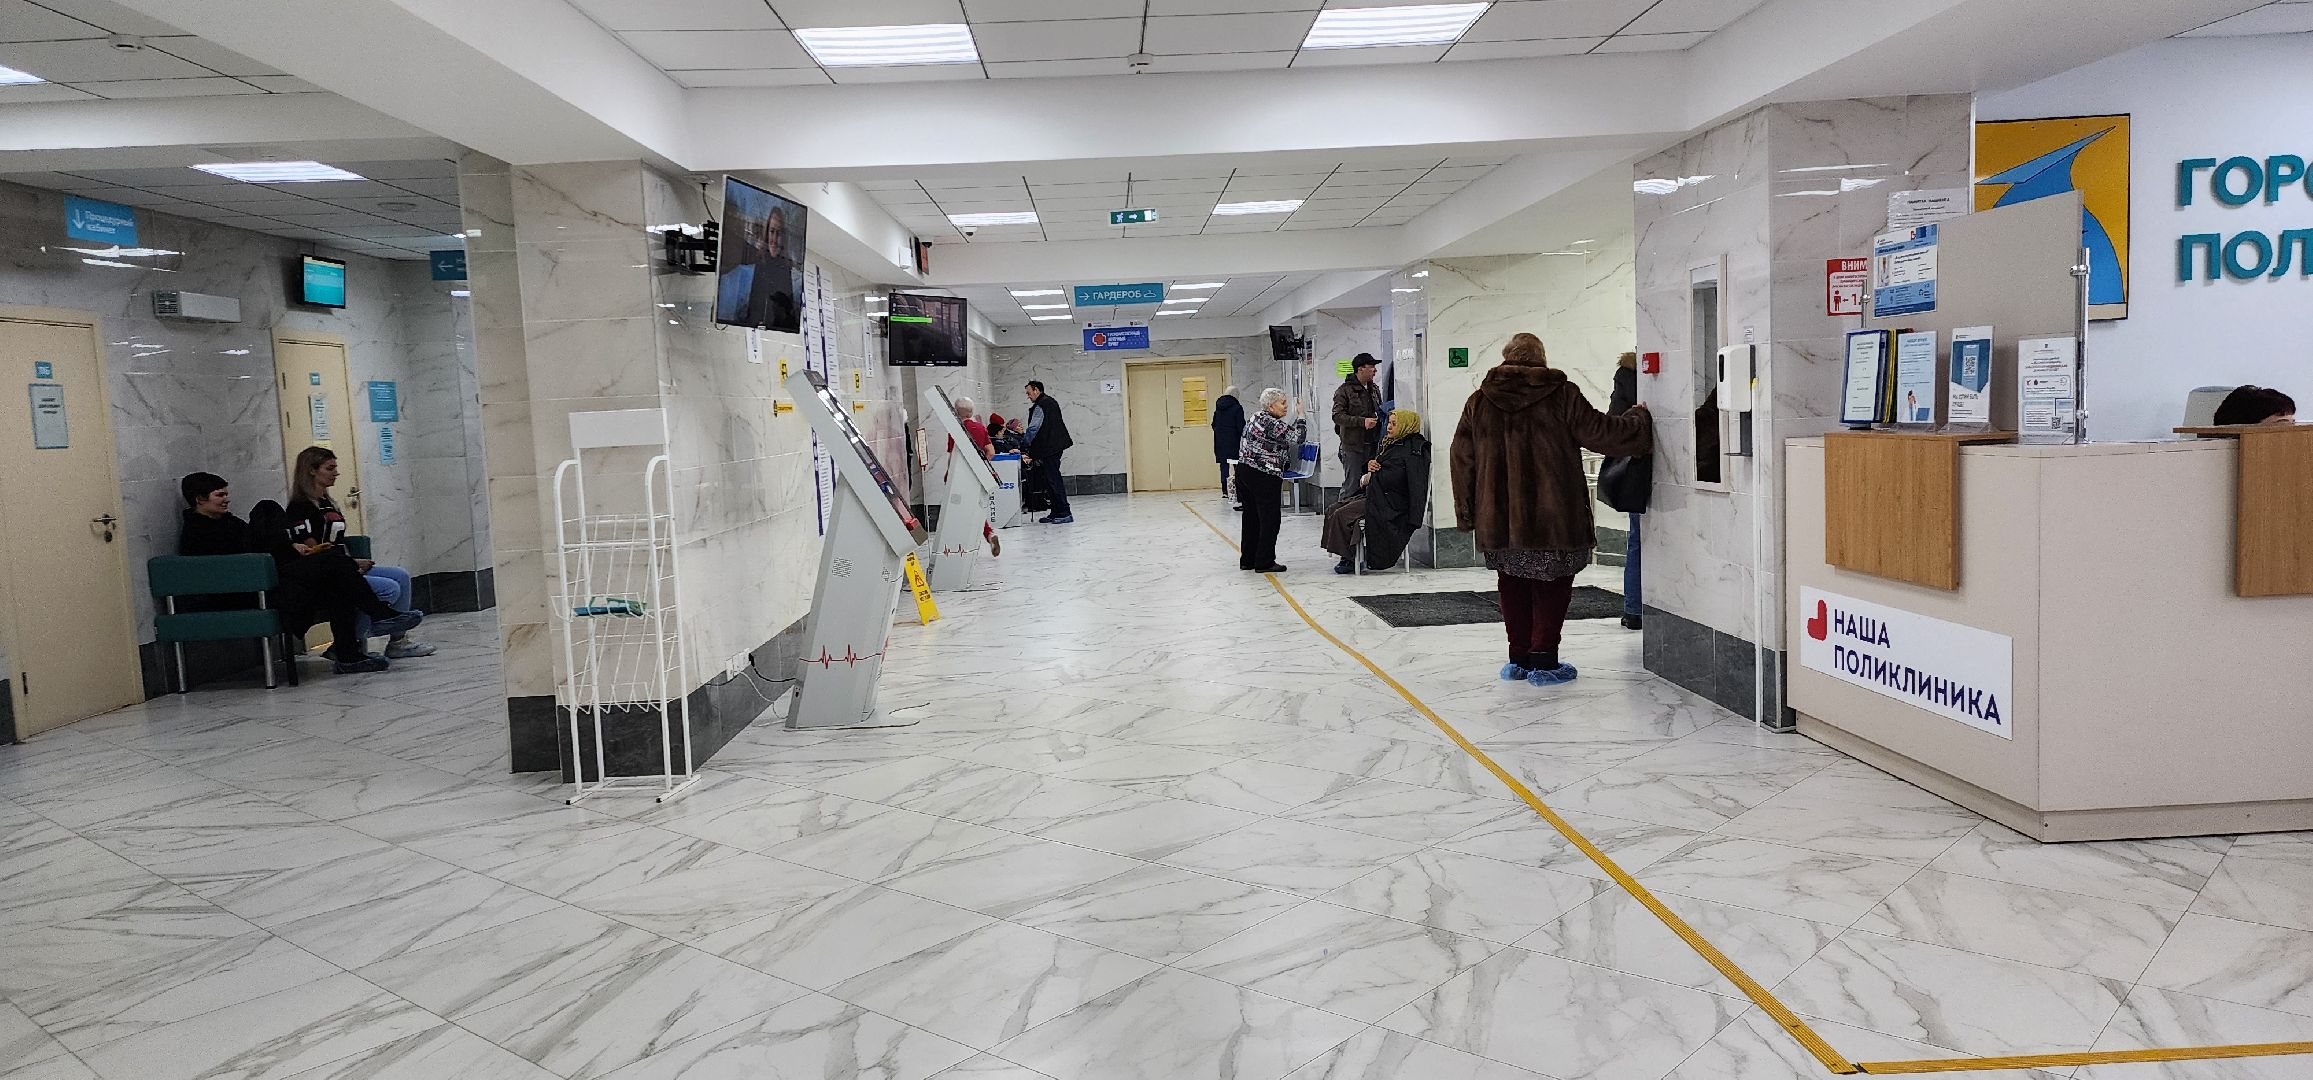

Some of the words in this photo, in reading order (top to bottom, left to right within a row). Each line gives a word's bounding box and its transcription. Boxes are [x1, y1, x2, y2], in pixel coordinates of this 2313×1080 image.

[2181, 154, 2313, 206] ГОР
[1092, 290, 1141, 300] ГАРДЕРОБ
[988, 491, 996, 523] ВАНИЕ
[1834, 608, 1891, 648] НАША
[1834, 644, 2002, 726] ПОЛИКЛИНИКА
